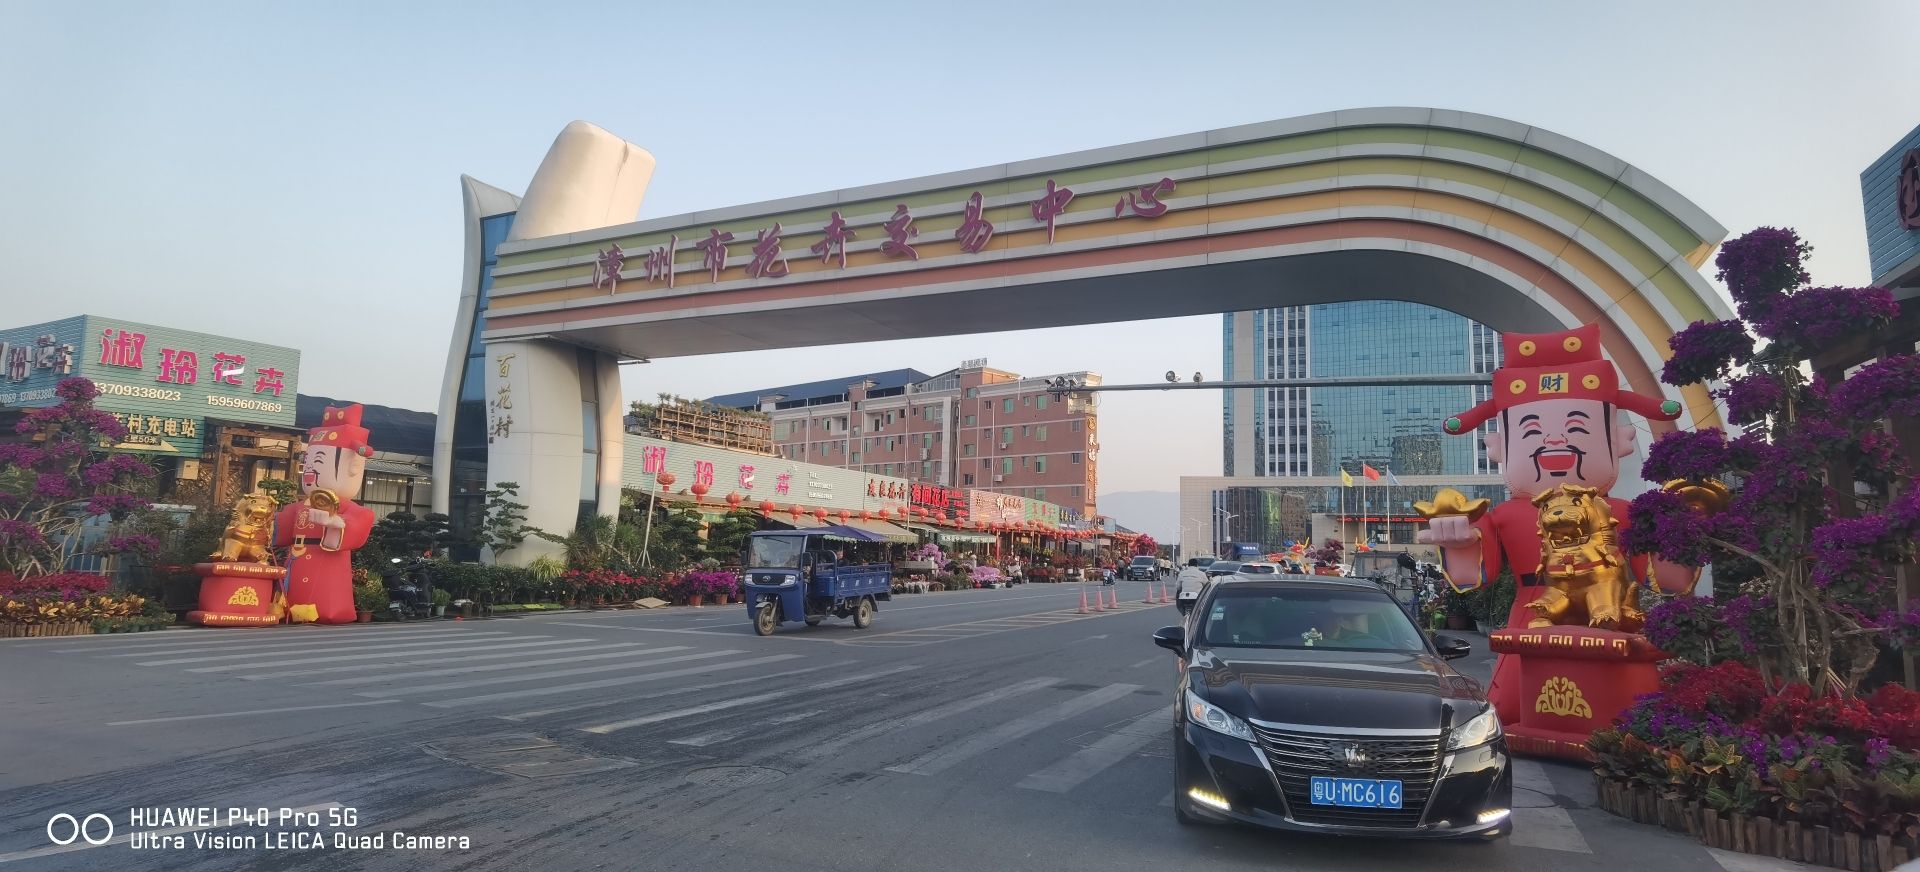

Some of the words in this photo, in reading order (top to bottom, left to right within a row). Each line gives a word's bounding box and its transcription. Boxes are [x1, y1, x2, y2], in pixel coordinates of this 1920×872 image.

[592, 177, 1176, 296] 漳州市花卉交易中心
[101, 328, 285, 397] 淑玲花卉
[1541, 374, 1564, 391] 财
[206, 395, 282, 413] 15959607869
[495, 353, 514, 438] 百花村
[642, 445, 793, 495] 淑玲花卉
